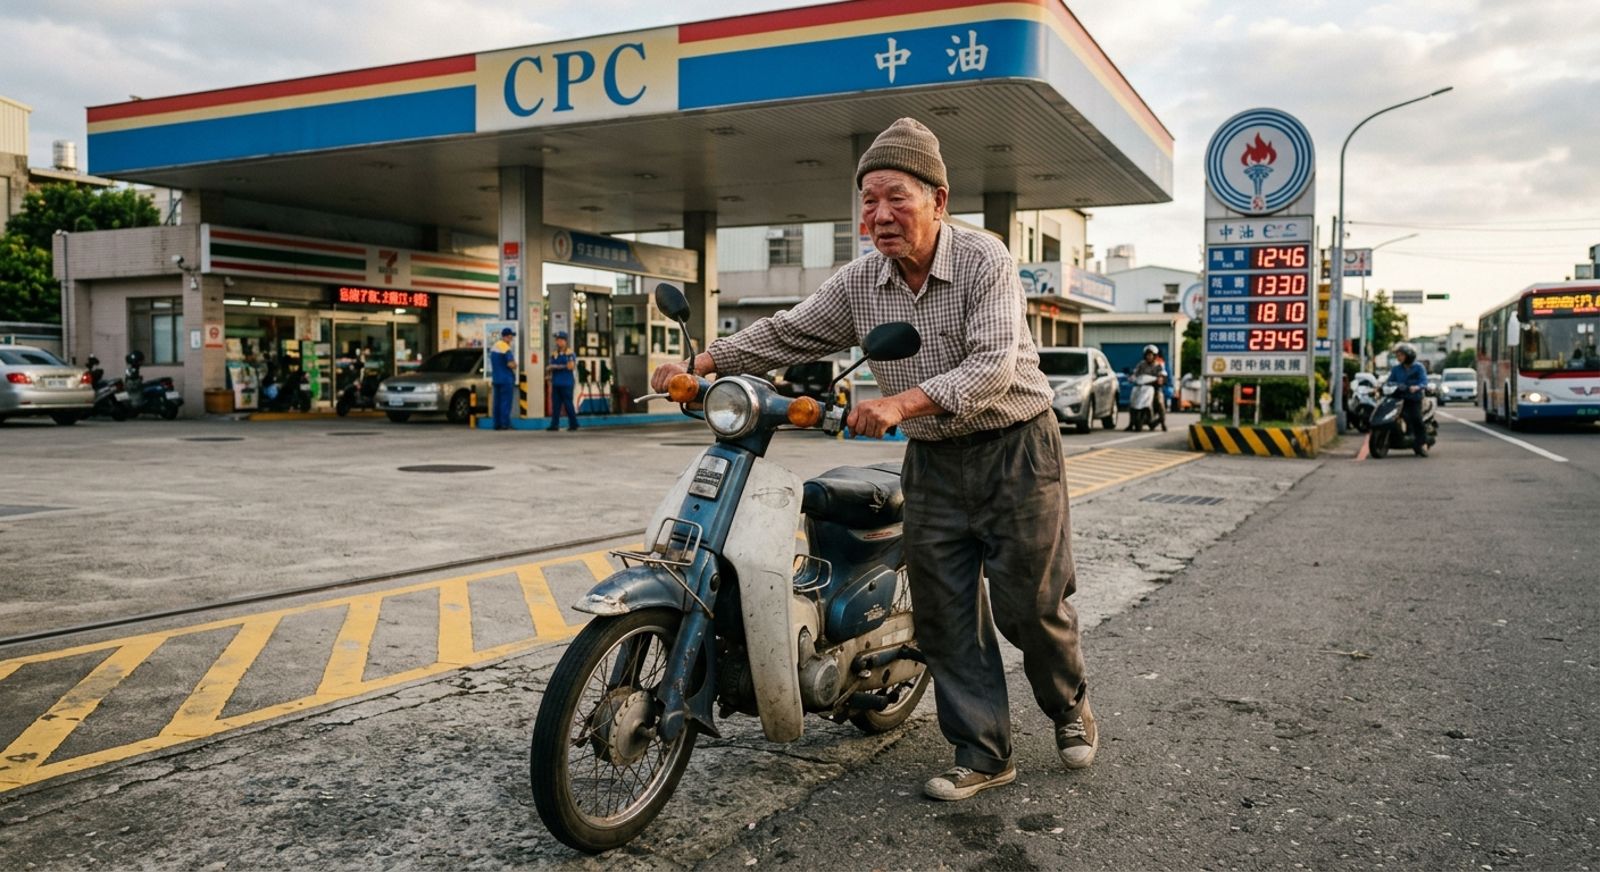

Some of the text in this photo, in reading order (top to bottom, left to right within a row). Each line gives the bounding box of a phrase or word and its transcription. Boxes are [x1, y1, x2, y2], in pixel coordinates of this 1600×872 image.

[874, 30, 989, 84] 中油
[503, 42, 647, 117] CPC
[1257, 247, 1305, 268] 1246
[1257, 275, 1305, 295] 1330
[1249, 329, 1304, 350] 2345
